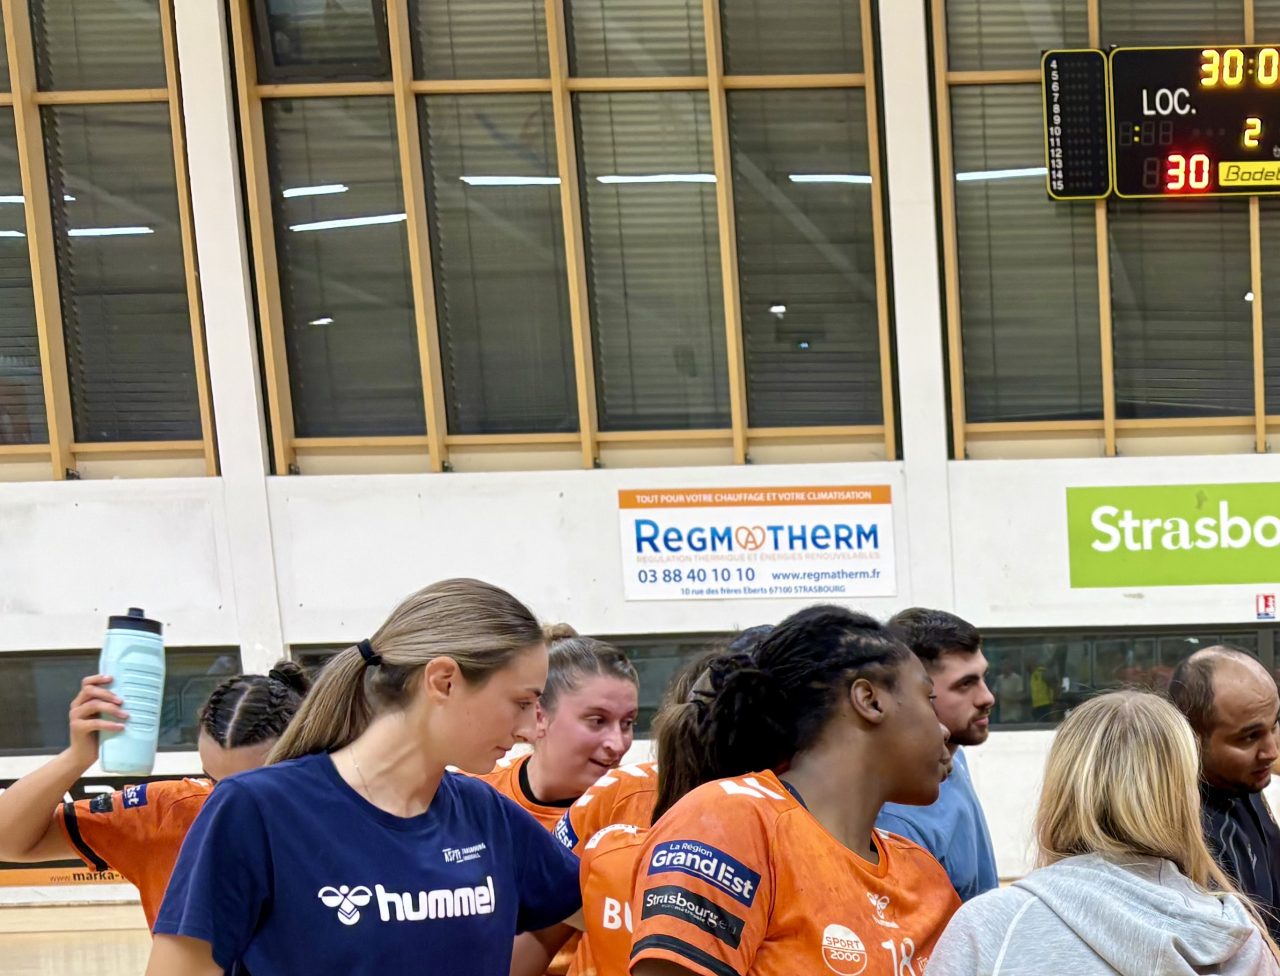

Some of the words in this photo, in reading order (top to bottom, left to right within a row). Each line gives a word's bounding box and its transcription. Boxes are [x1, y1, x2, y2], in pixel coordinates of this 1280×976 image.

[1050, 60, 1057, 69] 4
[1051, 71, 1059, 80] 5
[1051, 82, 1059, 91] 6
[1052, 93, 1059, 102] 7
[1142, 88, 1197, 115] LOC.
[1053, 104, 1060, 113] 8
[1053, 115, 1061, 125] 9
[1050, 126, 1061, 136] 10
[1244, 118, 1262, 147] 2
[1050, 138, 1060, 147] 11
[1050, 149, 1062, 157] 12
[1051, 159, 1063, 168] 13
[1051, 170, 1063, 179] 14
[1167, 154, 1210, 190] 30
[1052, 181, 1064, 190] 15
[635, 494, 658, 504] TOUT
[660, 493, 685, 503] POUR
[686, 493, 713, 503] VOTRE
[715, 492, 765, 502] CHAUFFAGE
[767, 492, 777, 501] ET
[779, 491, 806, 501] VOTRE
[807, 490, 872, 500] CLIMATISATION
[638, 569, 658, 583] 03
[662, 568, 682, 583] 88
[686, 568, 707, 582] 40
[712, 567, 731, 582] 10
[736, 567, 755, 581] 10
[772, 567, 880, 582] www.regmatherm.fr
[794, 585, 845, 593] STRASBOURG
[670, 843, 680, 851] La
[682, 843, 713, 858] Région
[652, 850, 719, 877] Grand
[717, 863, 754, 899] Est
[375, 876, 496, 922] hummel
[825, 937, 860, 949] SPORT
[830, 950, 861, 963] 2000
